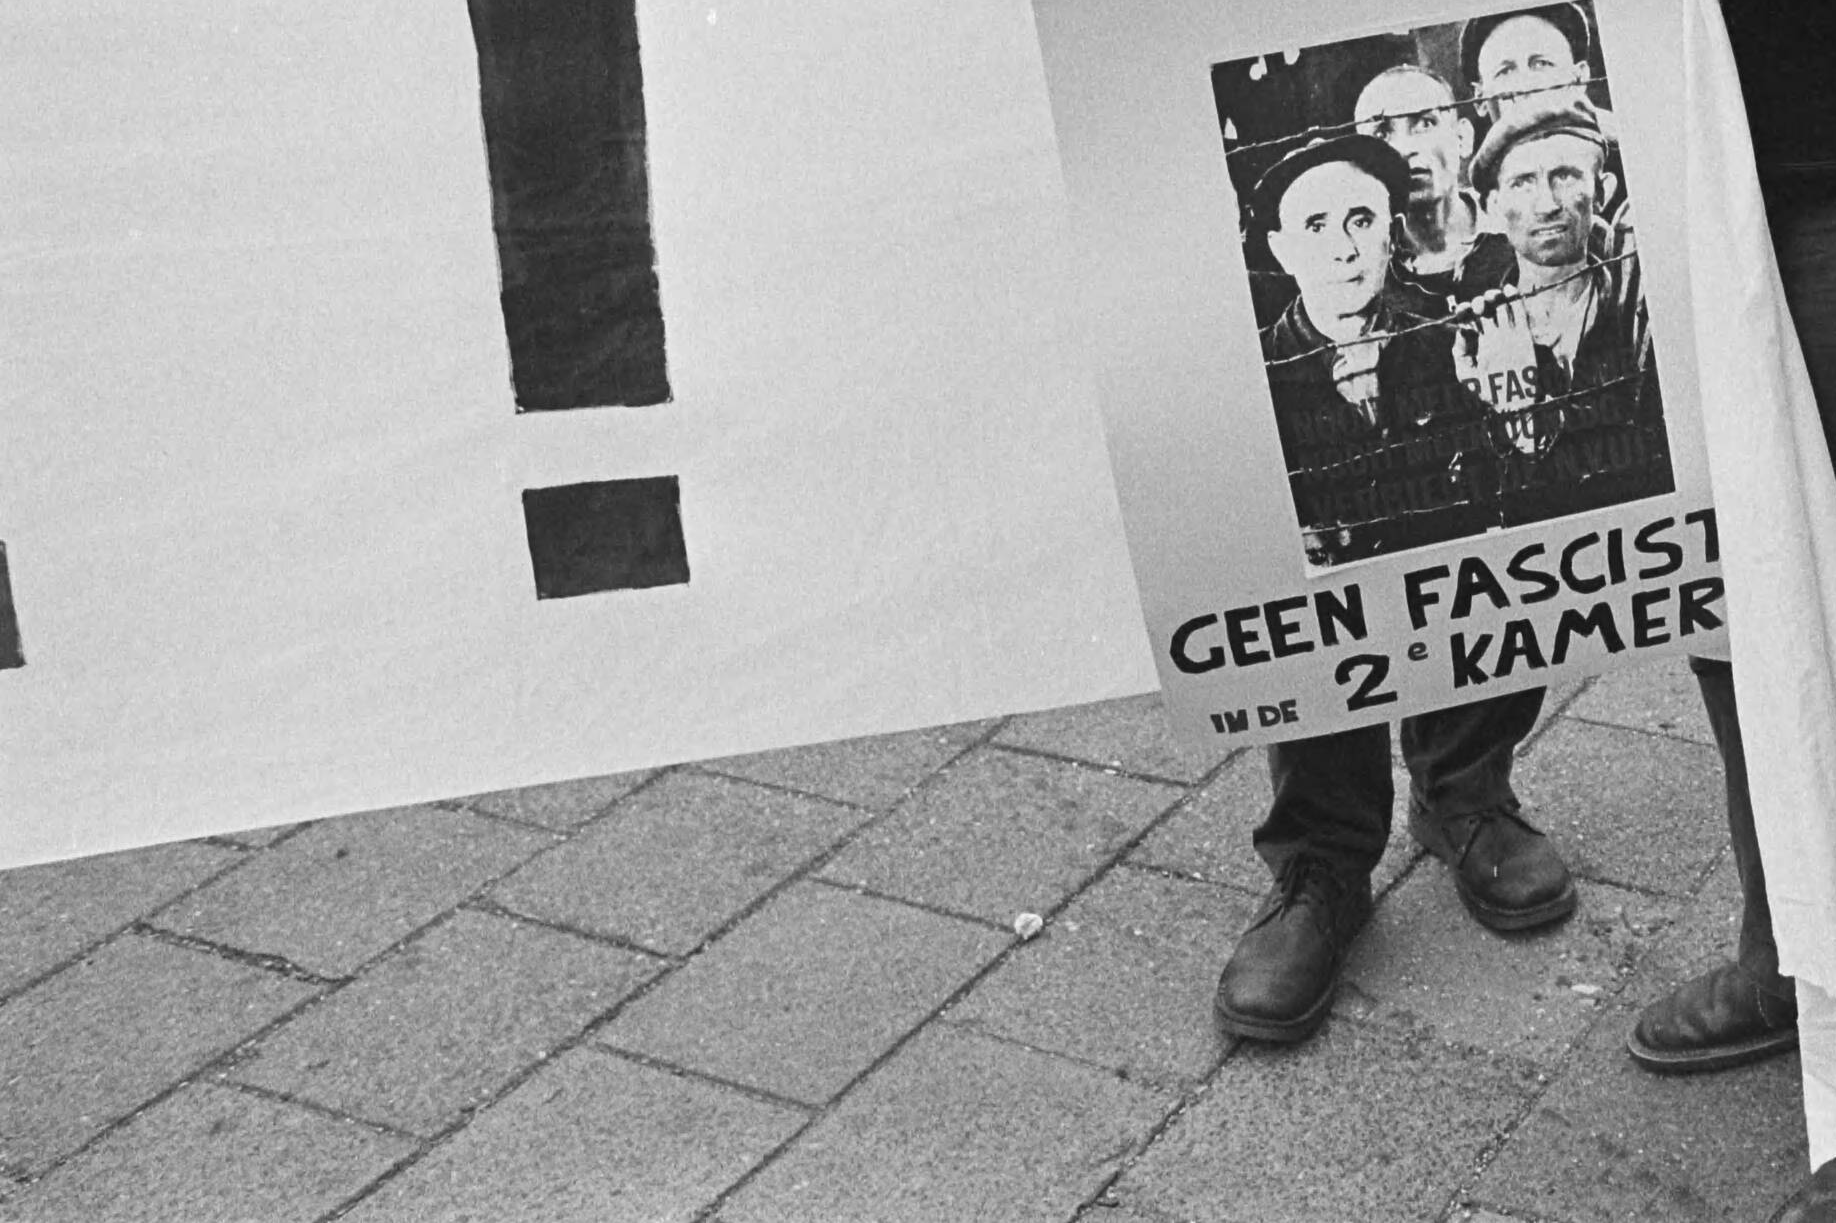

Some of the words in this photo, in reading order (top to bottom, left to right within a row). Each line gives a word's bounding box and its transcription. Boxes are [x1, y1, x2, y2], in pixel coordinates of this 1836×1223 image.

[1170, 583, 1368, 674] GEEN
[1404, 507, 1720, 630] FASCIST
[1210, 709, 1249, 733] IN
[1257, 699, 1299, 727] DE
[1450, 577, 1725, 688] KAMER
